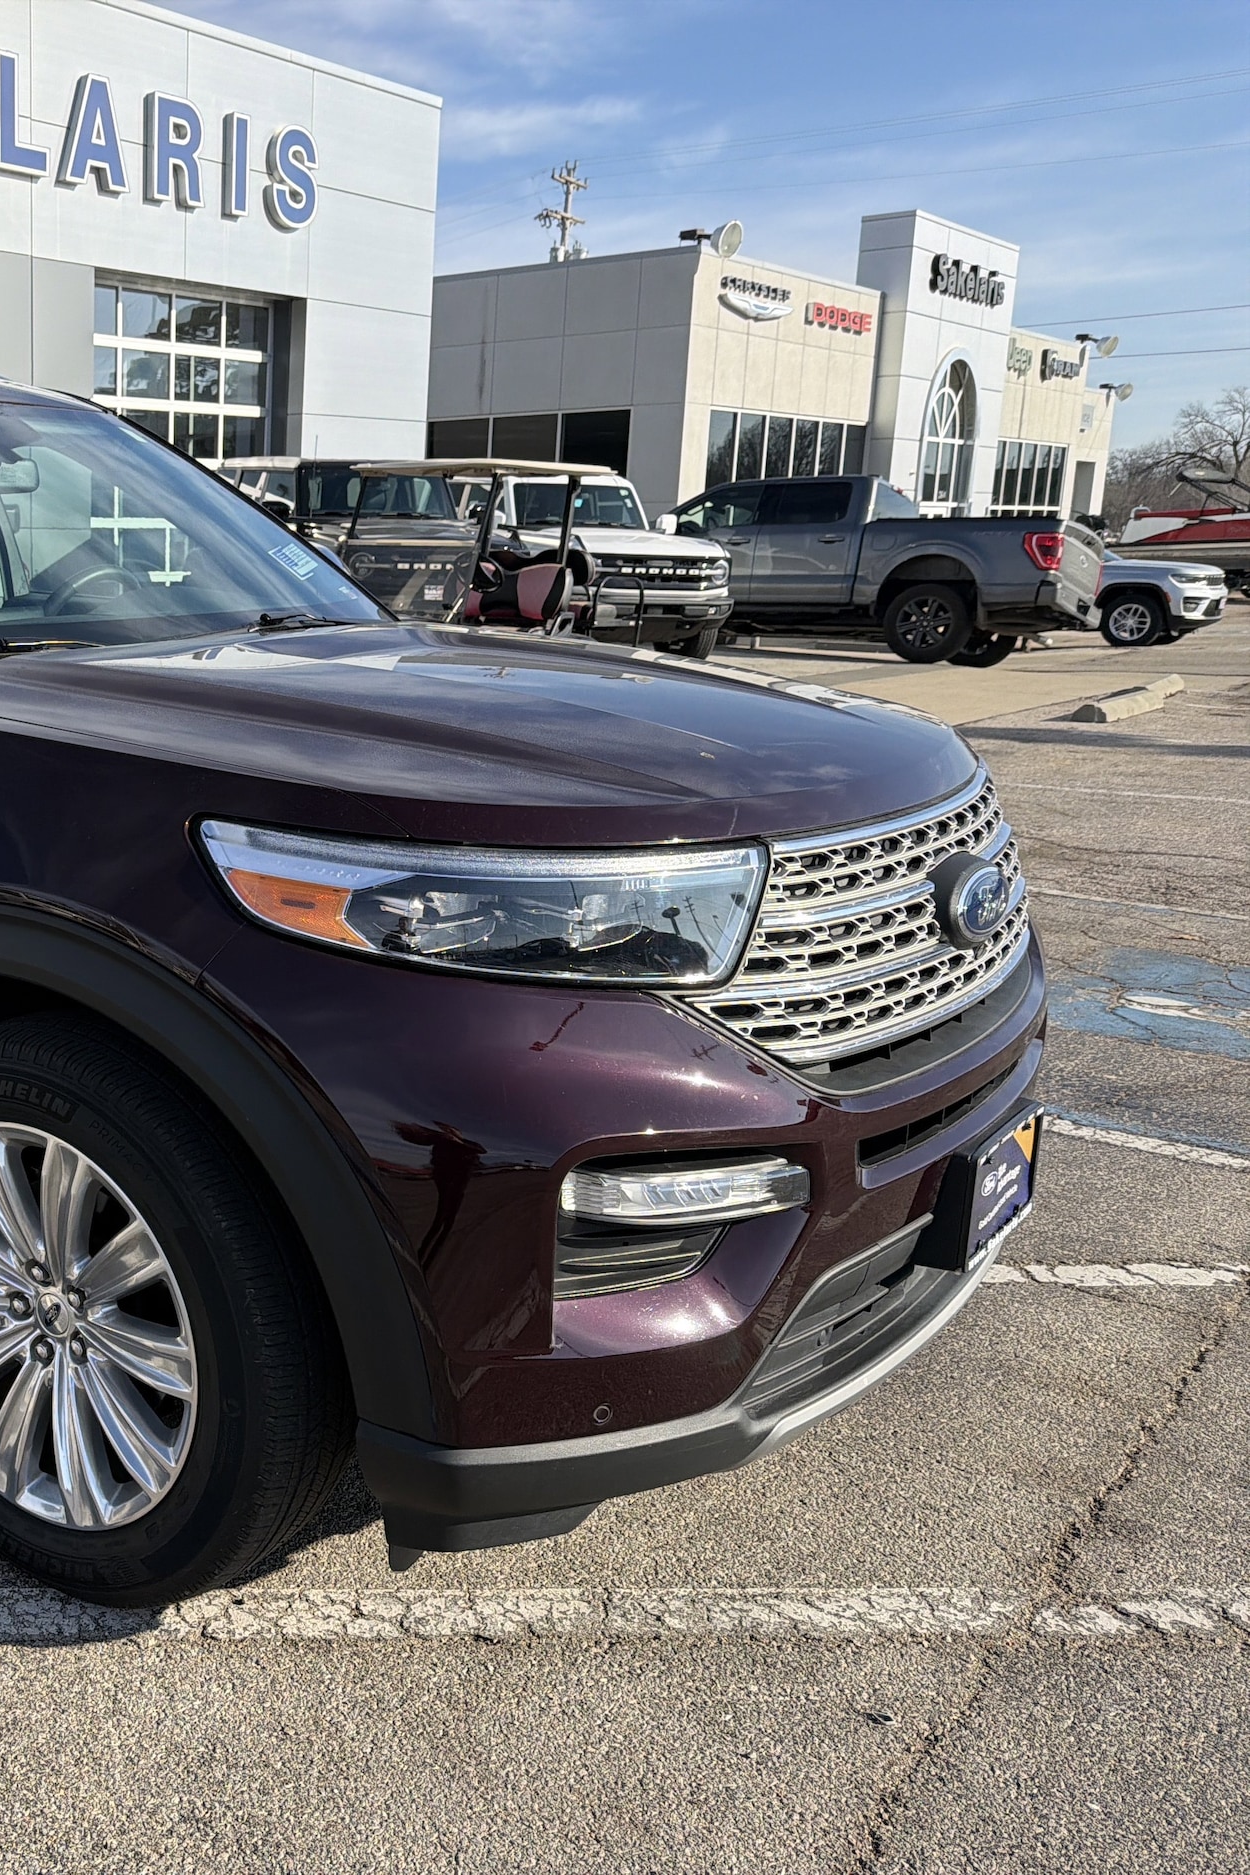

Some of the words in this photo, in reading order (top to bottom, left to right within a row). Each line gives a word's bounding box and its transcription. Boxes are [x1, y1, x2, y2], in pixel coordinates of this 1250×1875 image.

[723, 276, 791, 303] CHRYSLER
[933, 254, 1005, 306] Sakelaris
[811, 301, 872, 333] DODGE
[1007, 337, 1032, 378] Jeep
